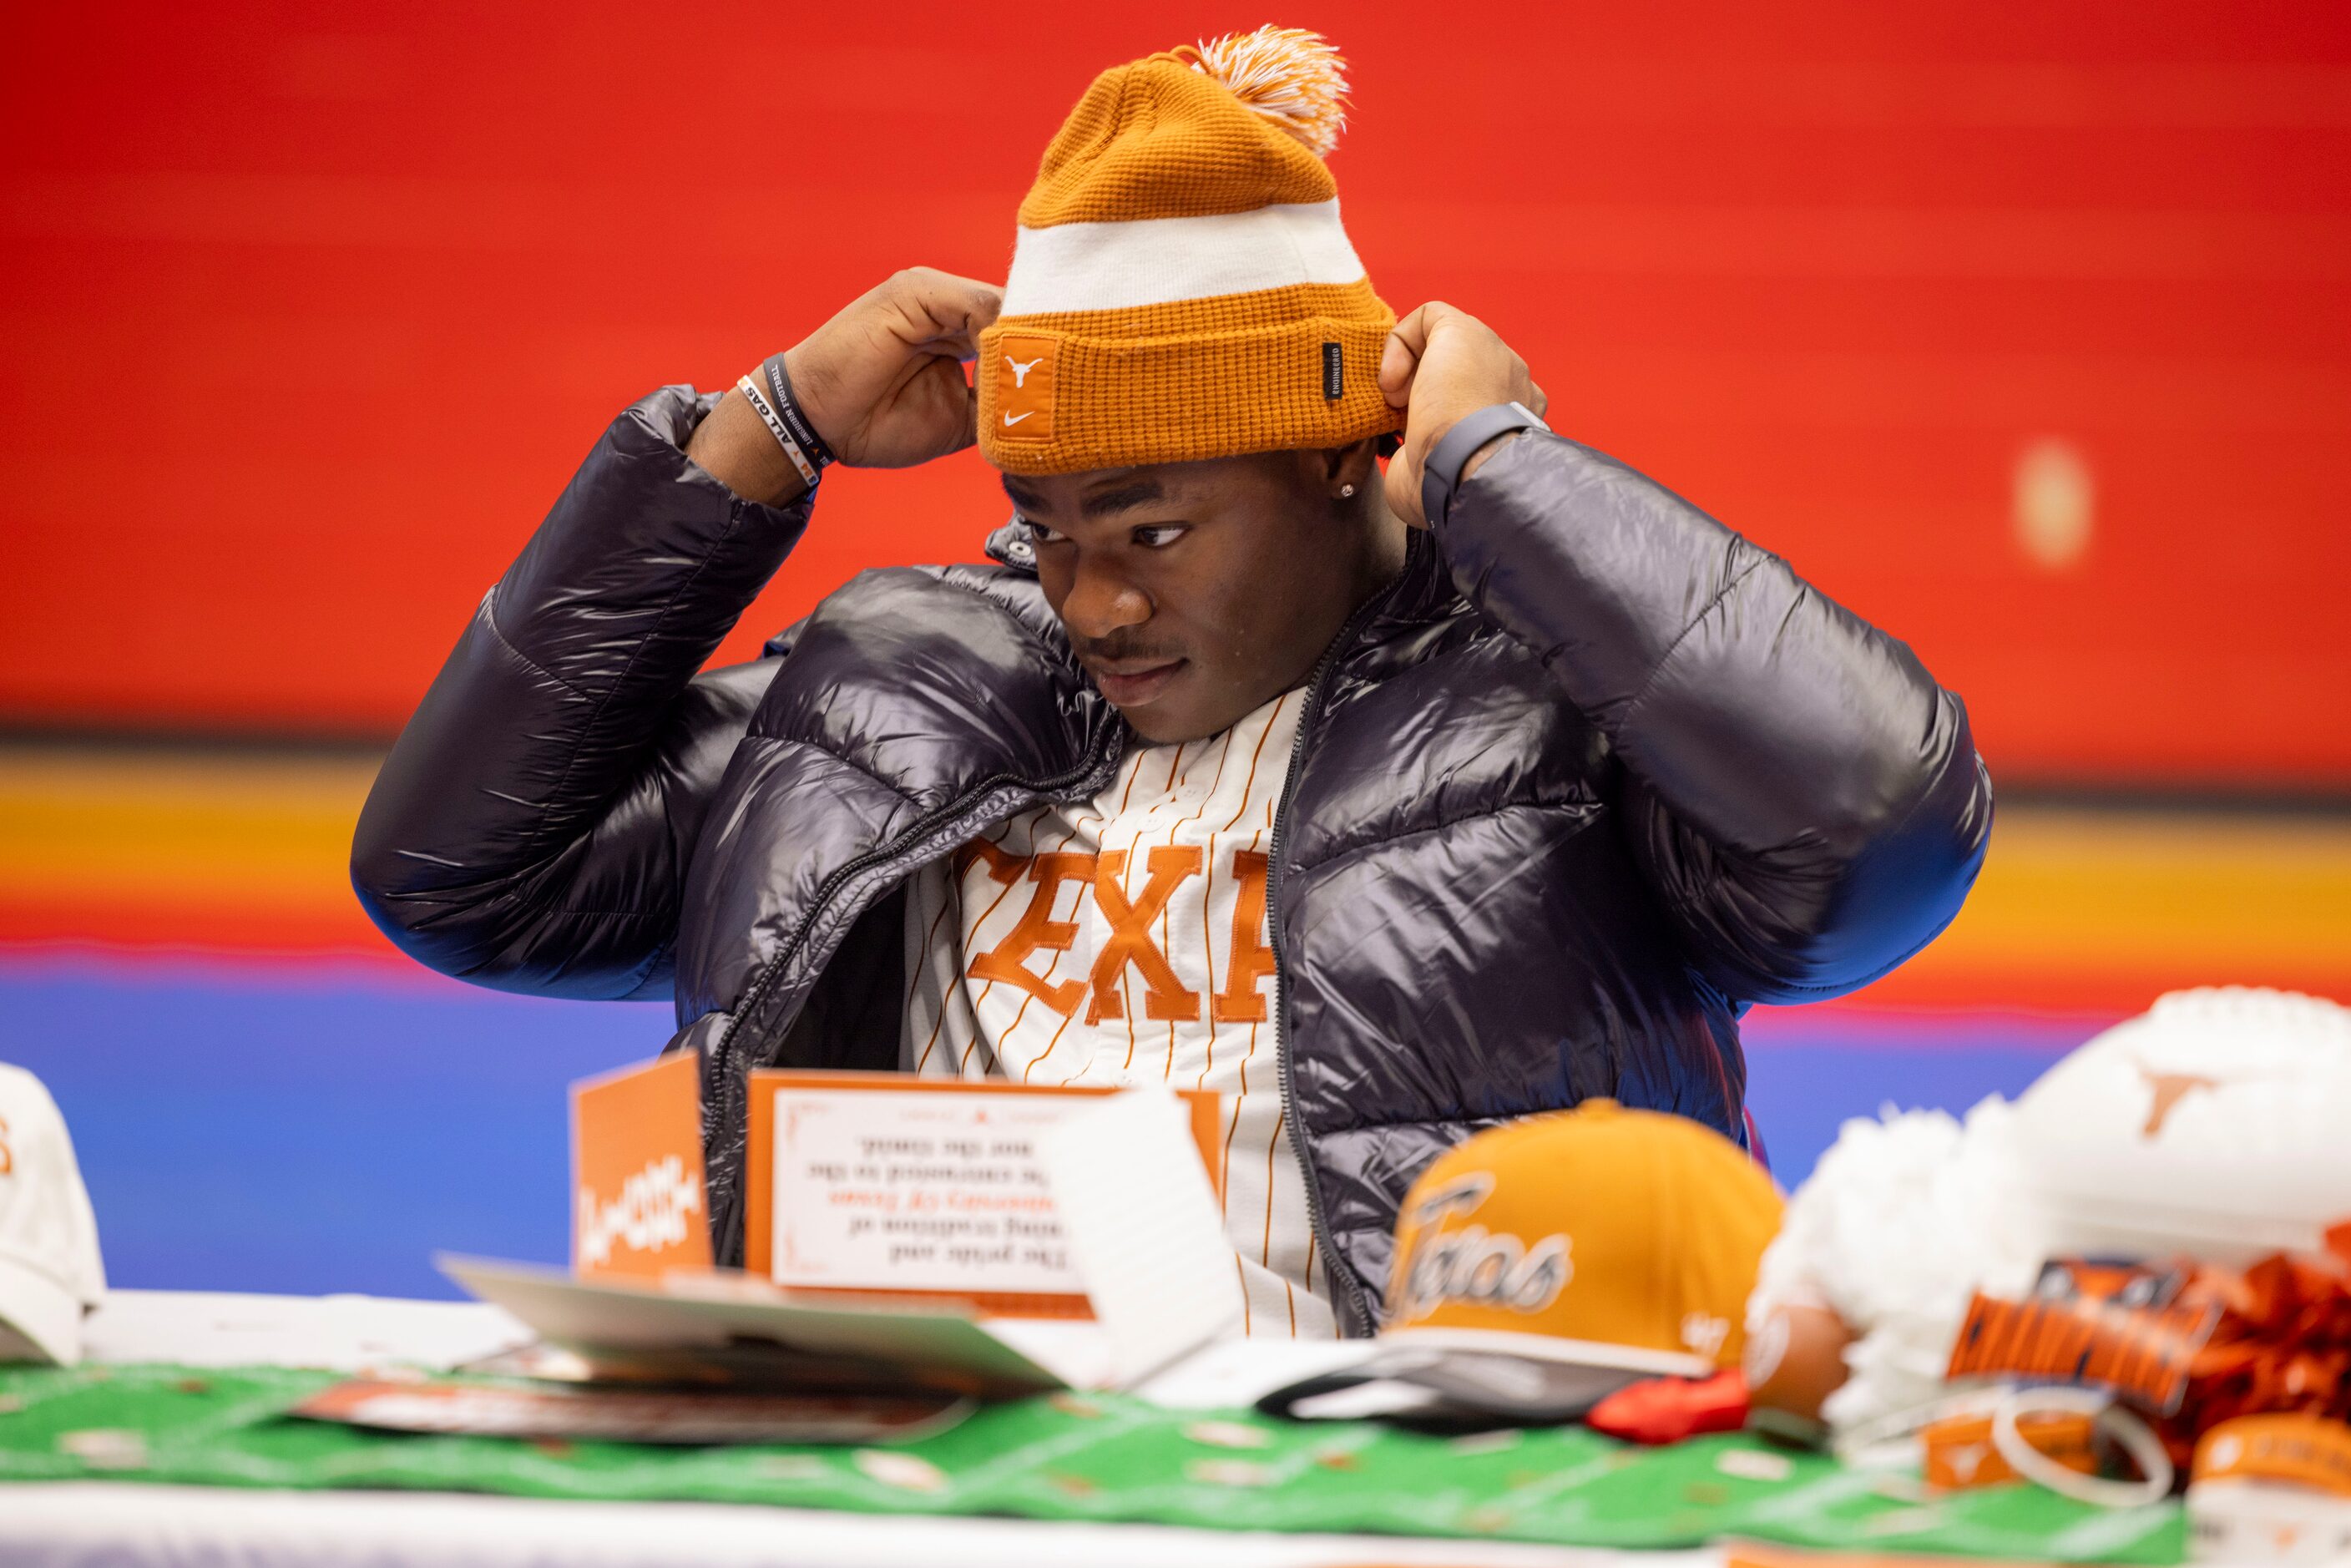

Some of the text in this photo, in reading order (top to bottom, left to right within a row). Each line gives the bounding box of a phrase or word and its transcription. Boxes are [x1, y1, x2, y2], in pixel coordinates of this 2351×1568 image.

[745, 387, 770, 416] GAS
[771, 364, 813, 445] LONGHORN FOOTBALL
[771, 418, 792, 444] ALL
